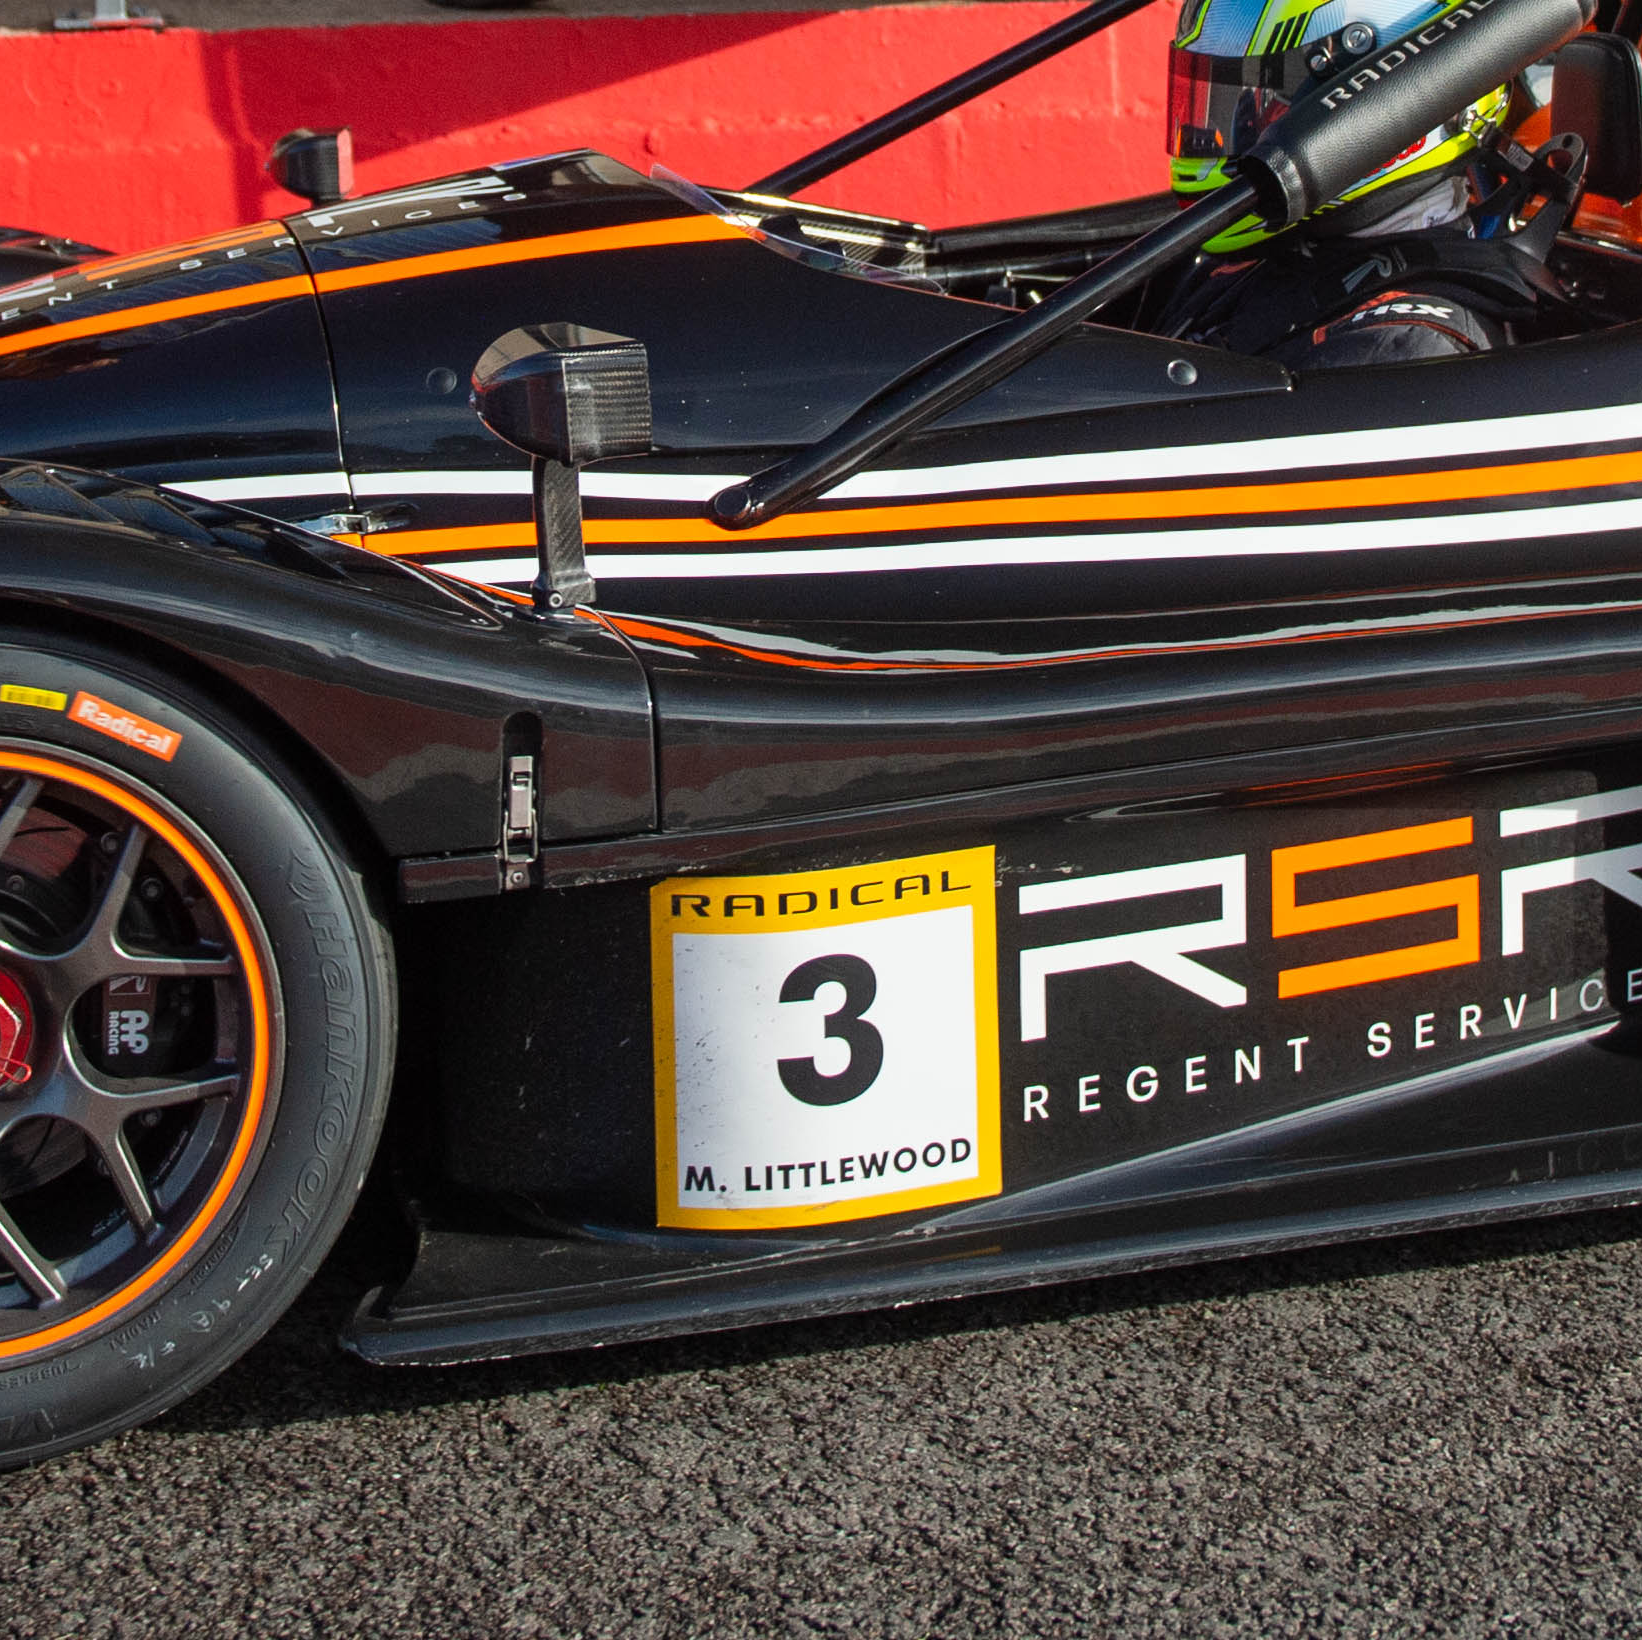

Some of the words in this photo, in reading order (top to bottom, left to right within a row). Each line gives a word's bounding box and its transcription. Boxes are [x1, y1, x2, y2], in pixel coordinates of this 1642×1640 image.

[78, 698, 173, 755] Radical
[670, 870, 972, 918] RADICAL
[108, 1010, 120, 1056] RACING
[776, 952, 885, 1108] 3
[1022, 1036, 1310, 1123] REGENT
[684, 1164, 728, 1193] M.
[744, 1137, 972, 1192] LITTLEWOOD
